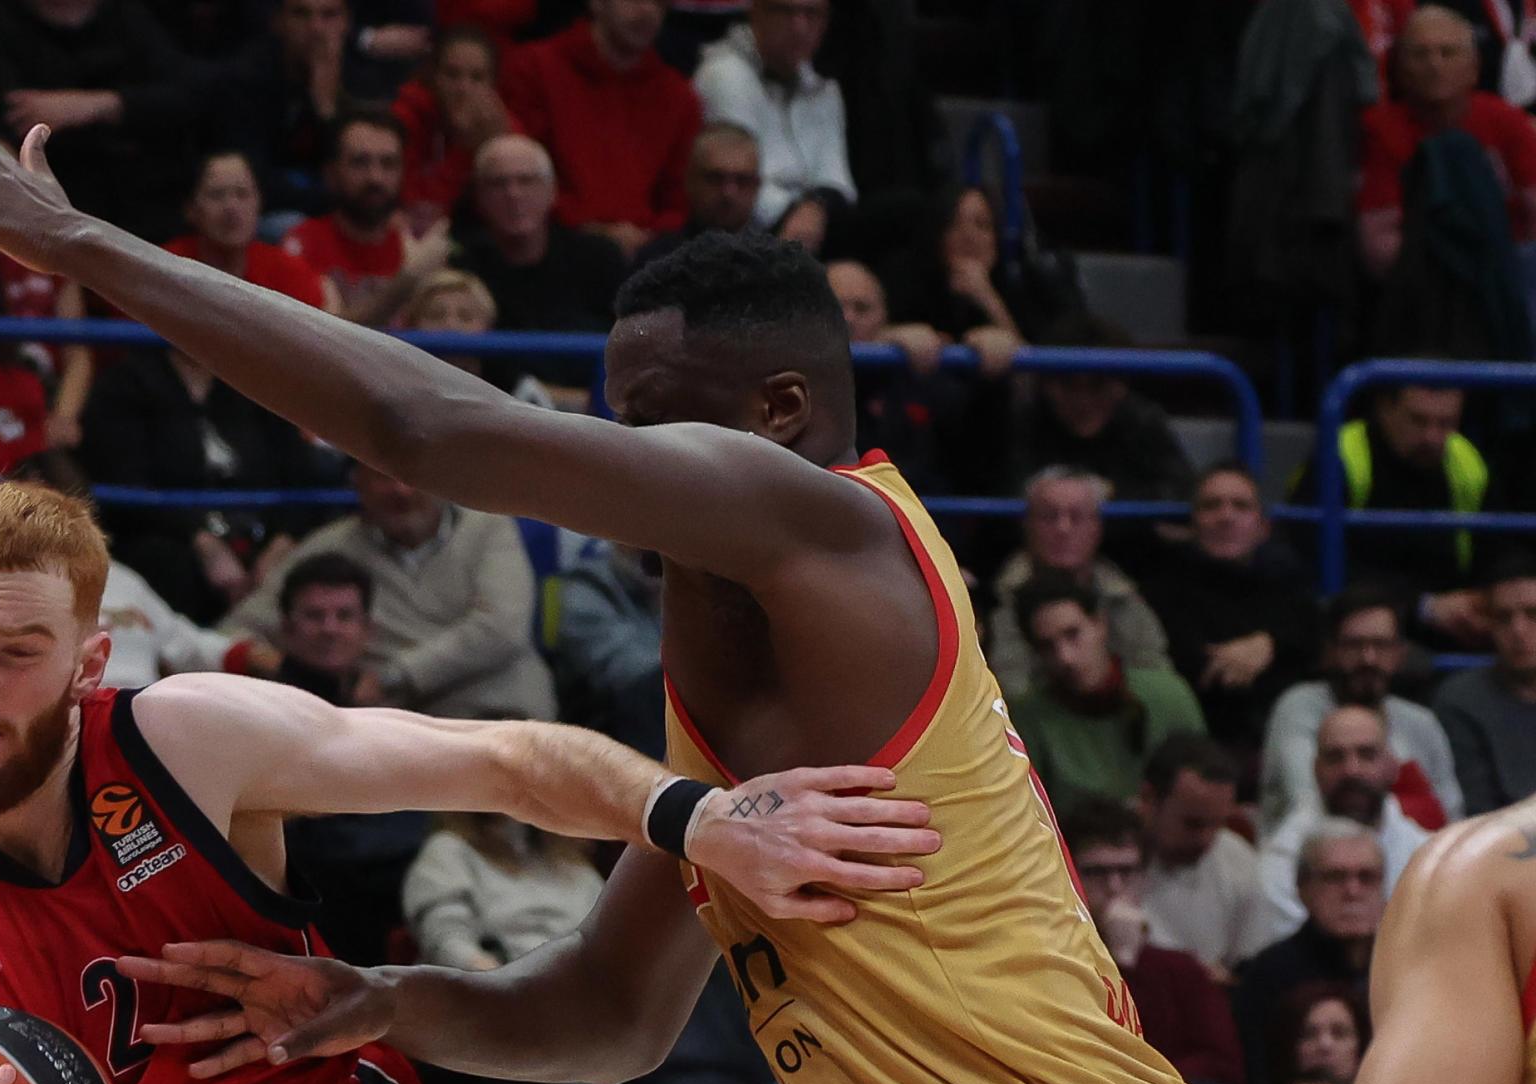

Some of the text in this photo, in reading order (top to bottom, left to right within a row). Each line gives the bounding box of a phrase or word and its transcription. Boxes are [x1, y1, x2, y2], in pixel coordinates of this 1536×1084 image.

[112, 821, 154, 849] TURKISH
[117, 829, 159, 858] AIRLINES
[117, 844, 186, 892] oneteam
[80, 957, 156, 1077] 2
